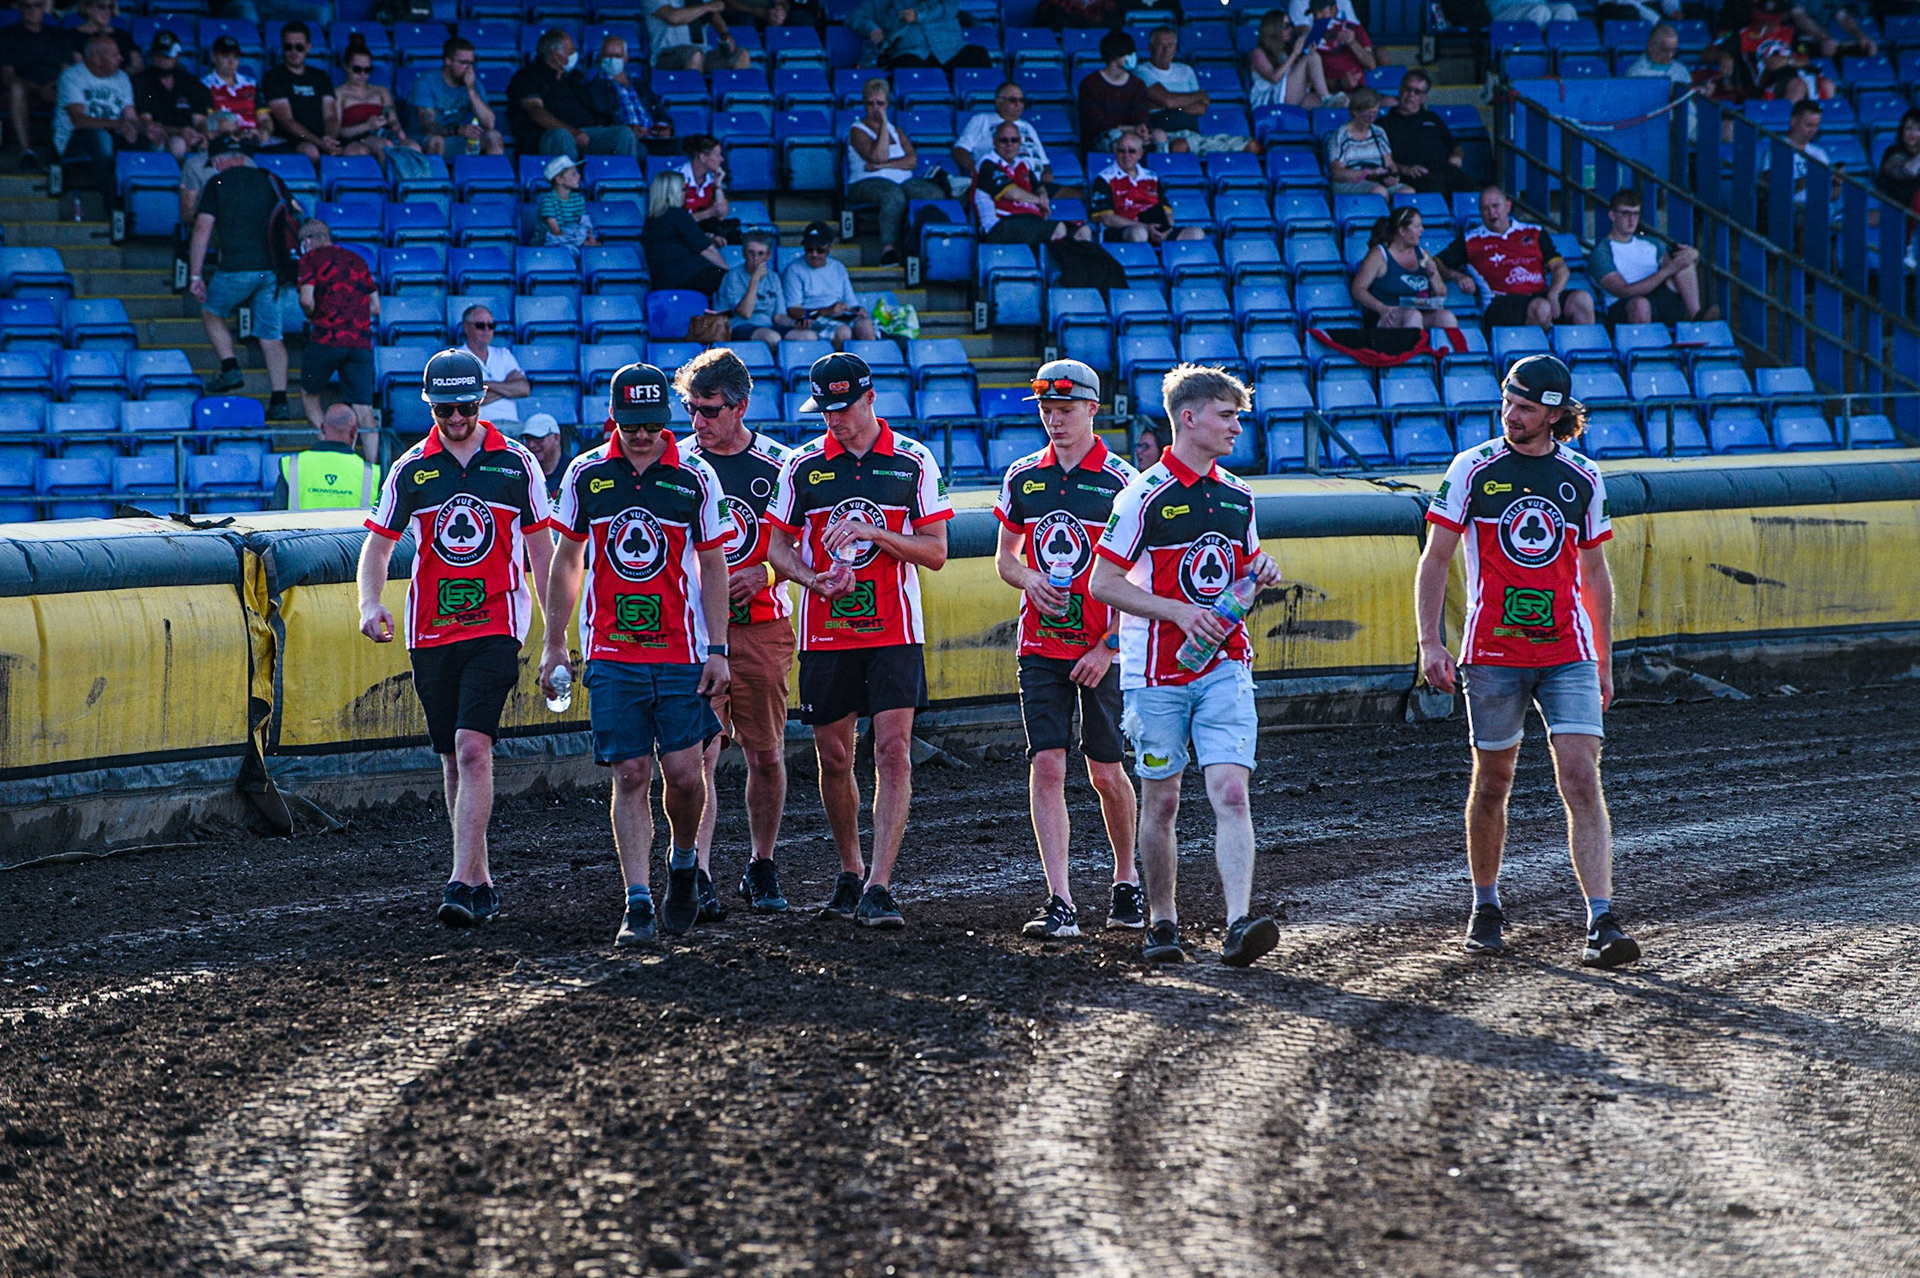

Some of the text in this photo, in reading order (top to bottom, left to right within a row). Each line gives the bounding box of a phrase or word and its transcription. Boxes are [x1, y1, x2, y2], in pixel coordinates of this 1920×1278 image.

[432, 376, 476, 386] POLCOPPER
[1117, 400, 1125, 415] C
[307, 487, 353, 495] CROWDSAFE
[456, 498, 473, 506] VUE
[474, 504, 491, 524] ACES
[630, 512, 646, 520] VUE
[736, 504, 754, 525] ACES
[867, 508, 883, 527] ACES
[1503, 501, 1562, 528] BELLE VUE ACES
[1035, 517, 1052, 540] BELLE
[1054, 515, 1069, 523] VUE
[824, 618, 884, 629] BIKERIGHT
